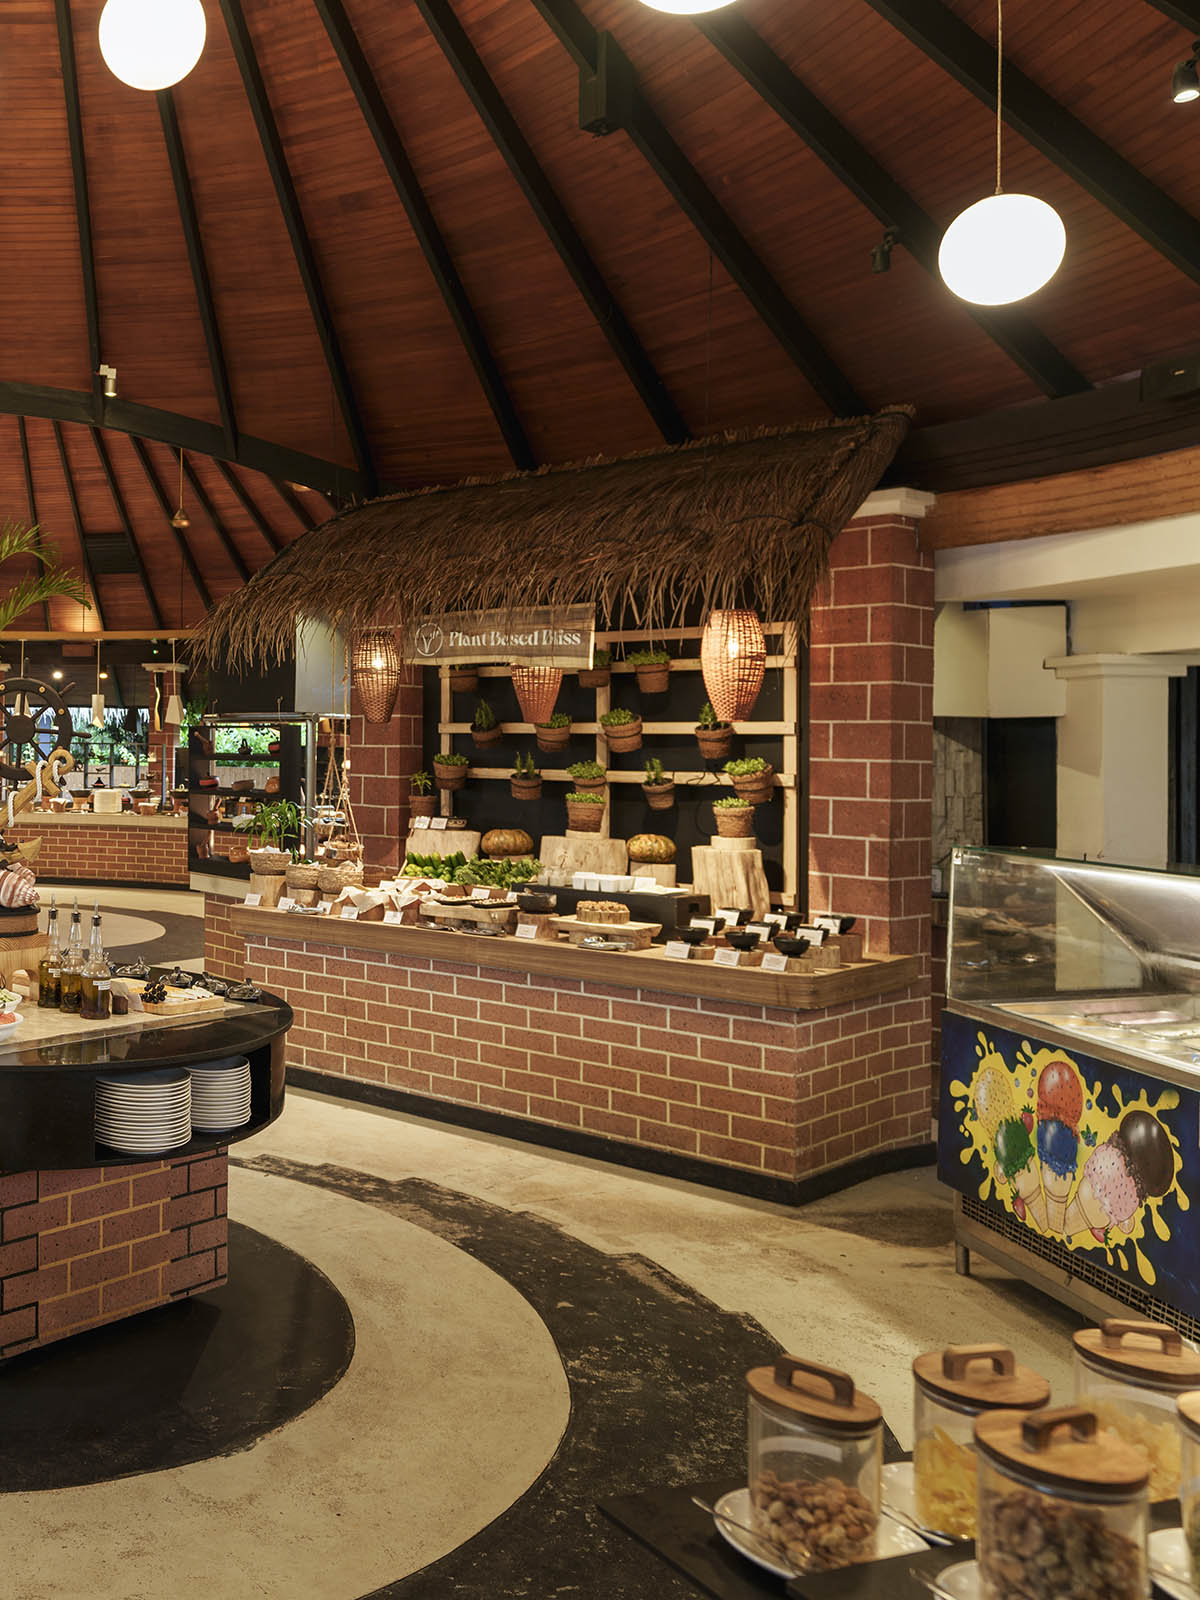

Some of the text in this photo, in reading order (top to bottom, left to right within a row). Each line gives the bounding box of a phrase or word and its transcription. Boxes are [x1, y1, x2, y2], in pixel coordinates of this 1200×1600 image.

[449, 629, 581, 647] Plant Based Bliss
